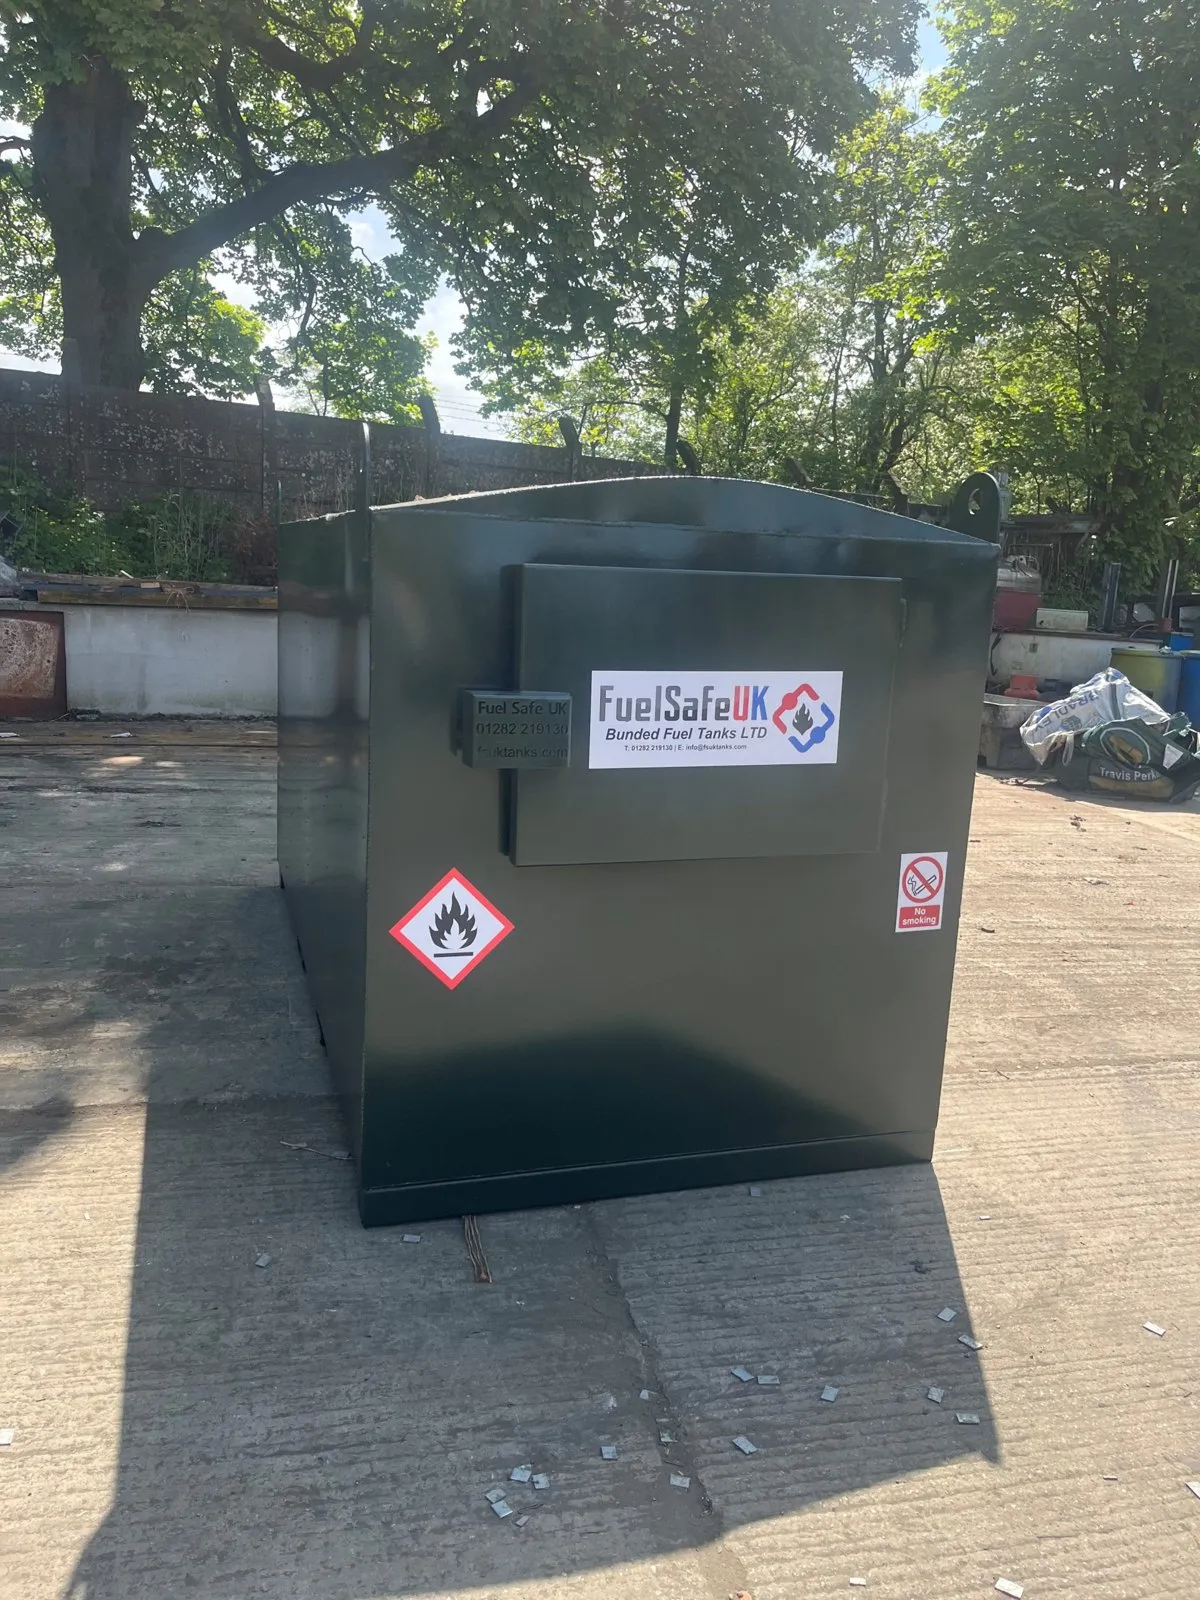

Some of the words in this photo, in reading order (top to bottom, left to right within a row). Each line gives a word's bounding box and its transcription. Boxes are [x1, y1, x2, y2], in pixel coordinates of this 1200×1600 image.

[478, 701, 506, 715] Fuel
[511, 701, 543, 715] Safe
[548, 702, 568, 715] UK
[599, 685, 769, 722] FuelSafeUK
[476, 722, 517, 735] 01282
[520, 722, 569, 735] 219130
[605, 727, 661, 740] Bunded
[663, 727, 693, 740] Fuel
[698, 726, 737, 739] Tanks
[741, 726, 768, 739] LTD
[685, 743, 747, 751] info@fsuktanks.com
[1100, 766, 1131, 781] Travis
[914, 907, 926, 915] No
[902, 916, 936, 926] smoking
